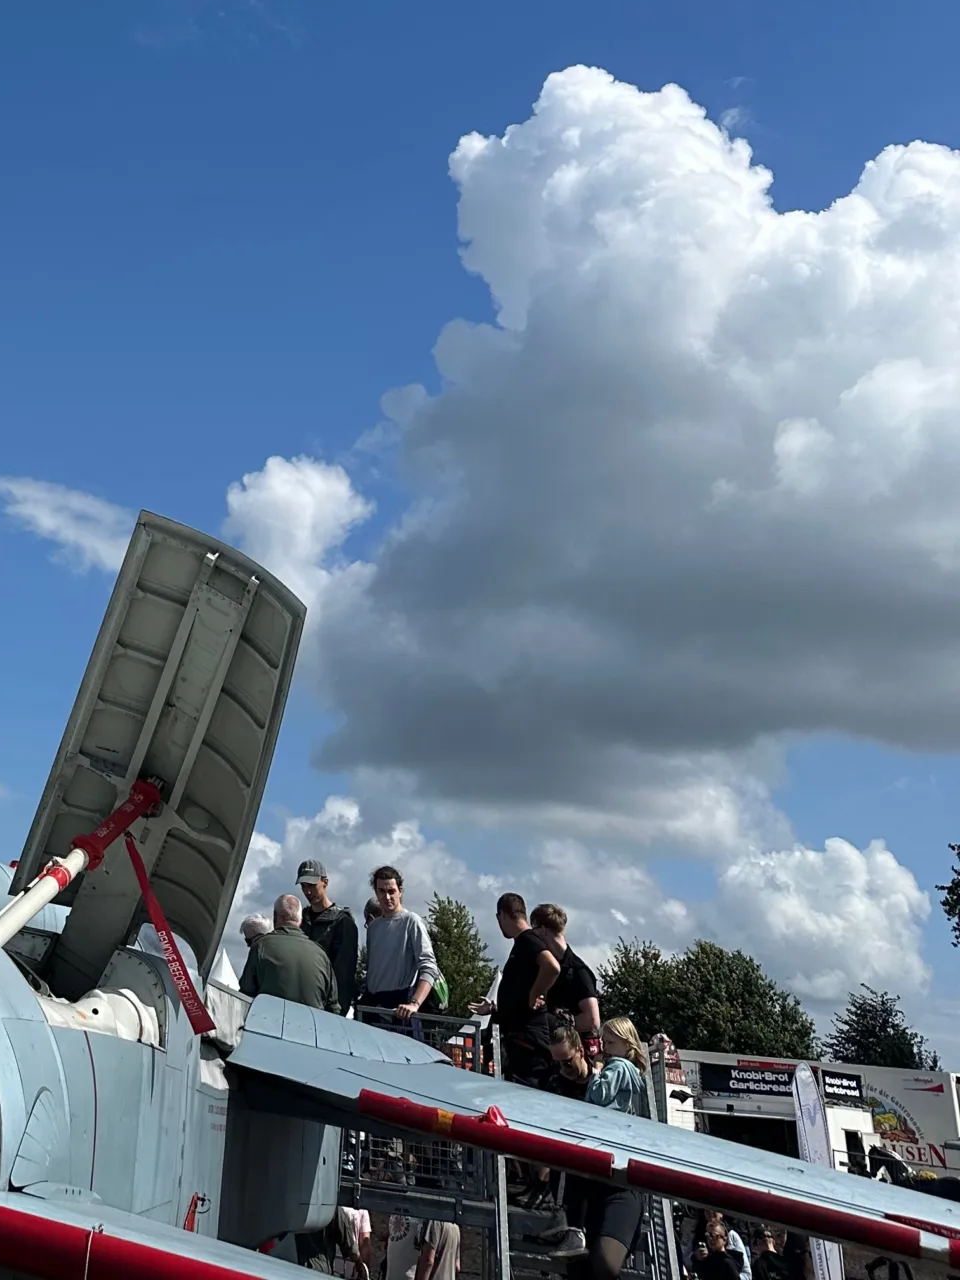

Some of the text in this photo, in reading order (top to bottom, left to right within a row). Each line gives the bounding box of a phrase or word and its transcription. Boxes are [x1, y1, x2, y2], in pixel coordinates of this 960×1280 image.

[157, 930, 202, 1016] REMOVE BEFORE FLIGHT
[729, 1080, 792, 1092] Garlicbread
[879, 1088, 889, 1099] die
[890, 1096, 925, 1140] Gastronomie
